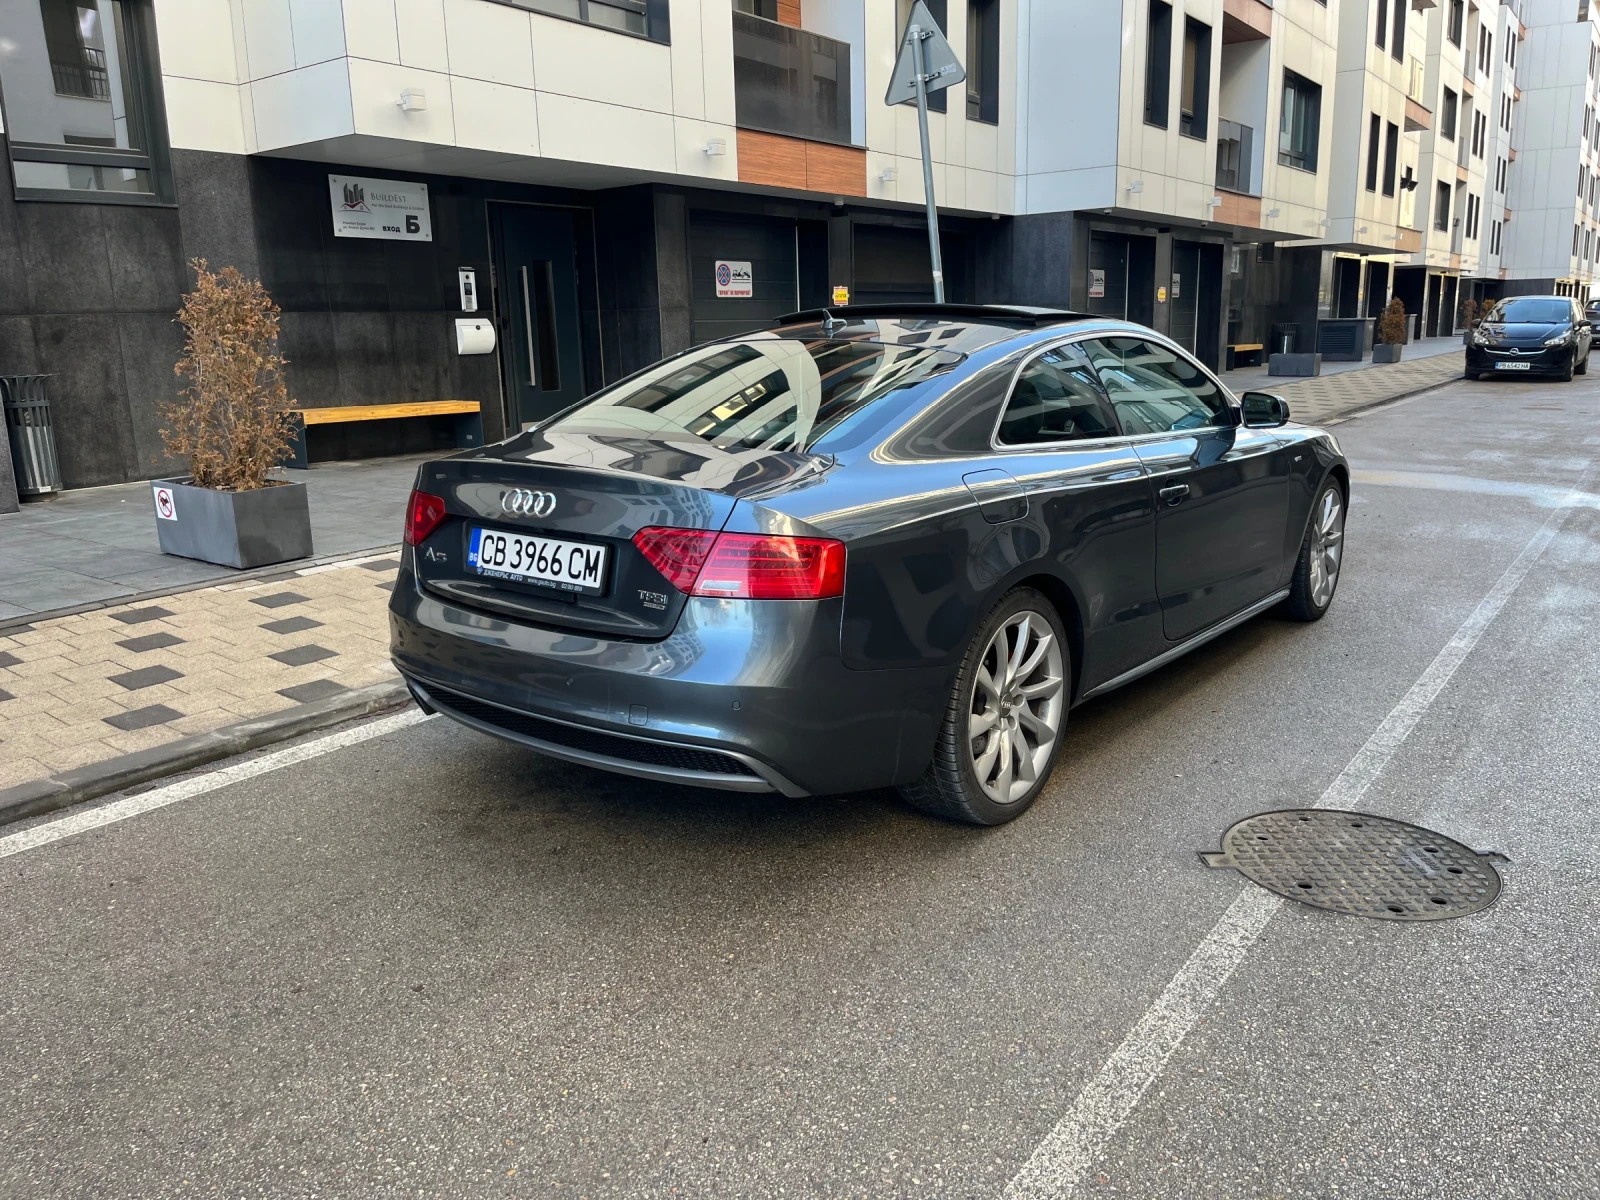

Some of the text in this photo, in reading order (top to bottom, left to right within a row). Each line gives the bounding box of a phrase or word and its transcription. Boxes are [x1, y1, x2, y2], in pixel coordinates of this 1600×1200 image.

[405, 215, 421, 234] Б
[469, 552, 479, 562] BG
[482, 535, 601, 583] CB 3966 CM
